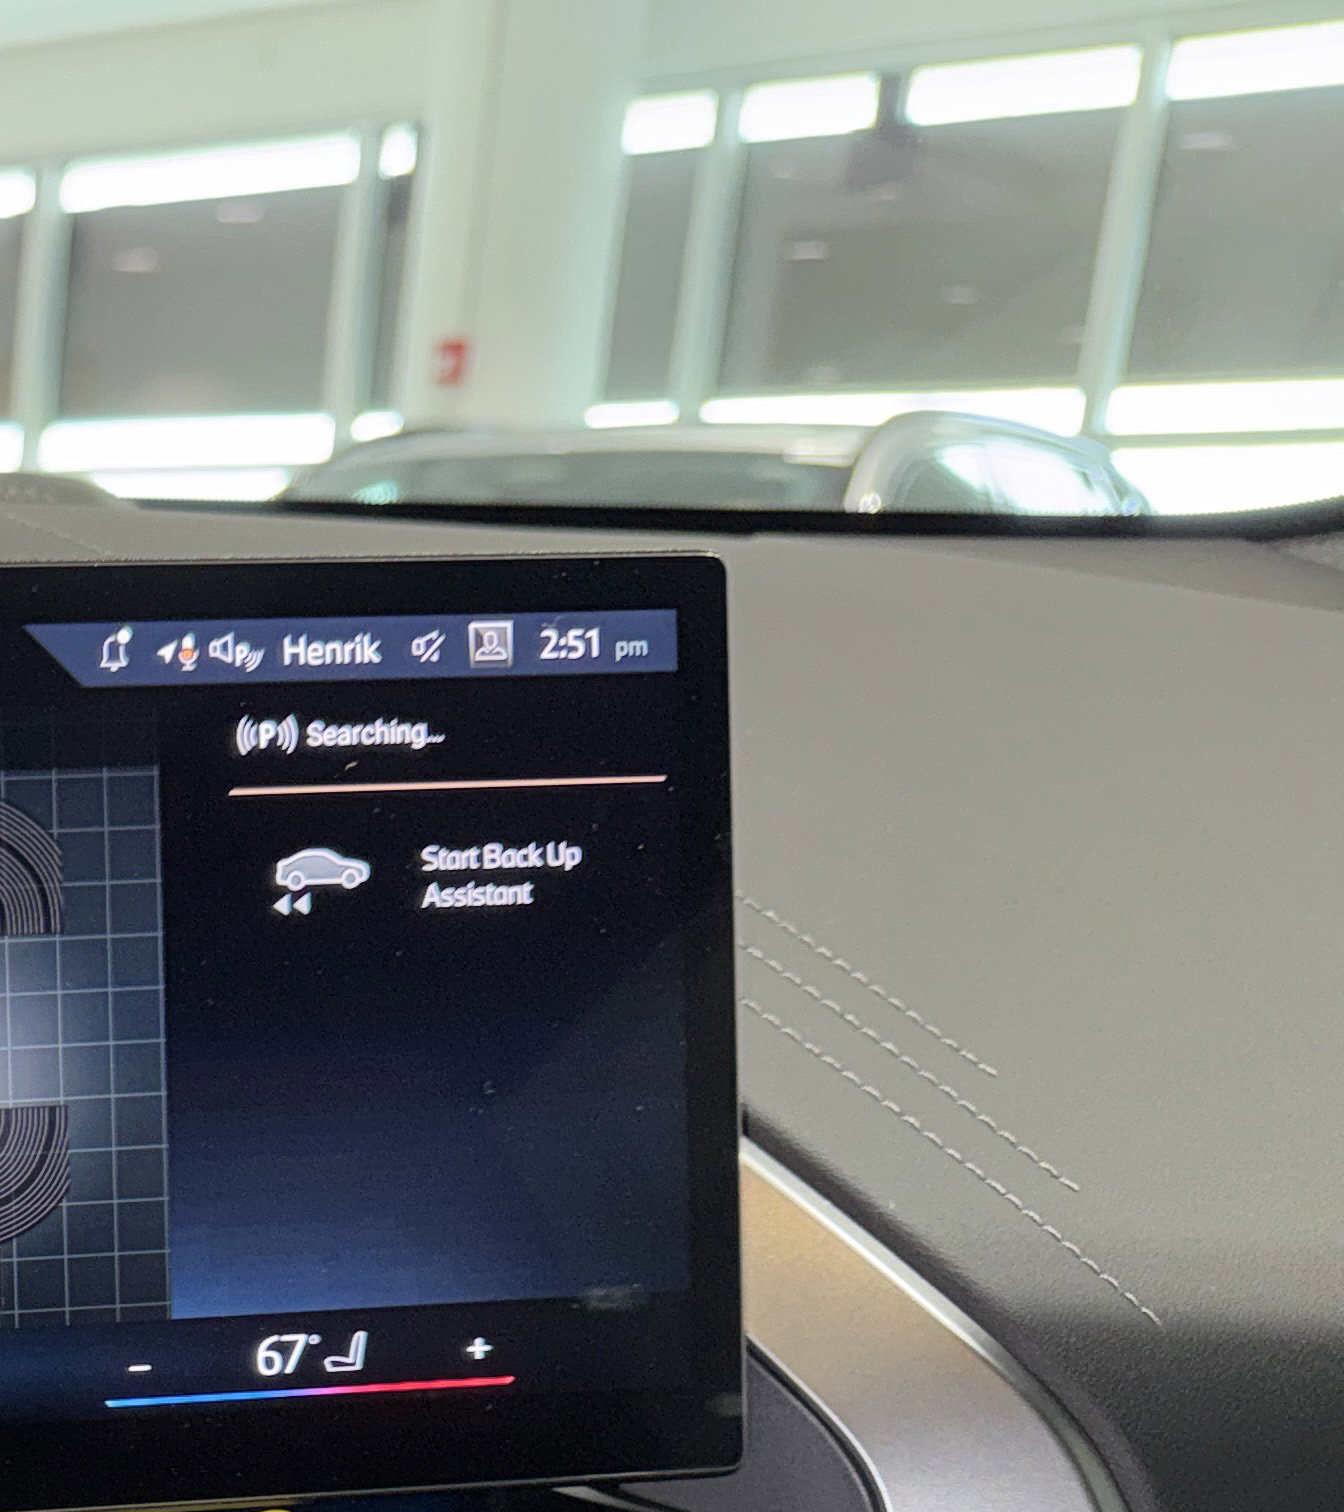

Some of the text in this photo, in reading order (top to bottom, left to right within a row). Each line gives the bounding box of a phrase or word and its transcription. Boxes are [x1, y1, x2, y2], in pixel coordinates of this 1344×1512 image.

[283, 633, 381, 666] Henrik
[540, 629, 648, 661] 2:51 pm
[306, 718, 445, 749] Searching...
[421, 842, 582, 872] Start Back Up
[421, 881, 533, 909] Assistant
